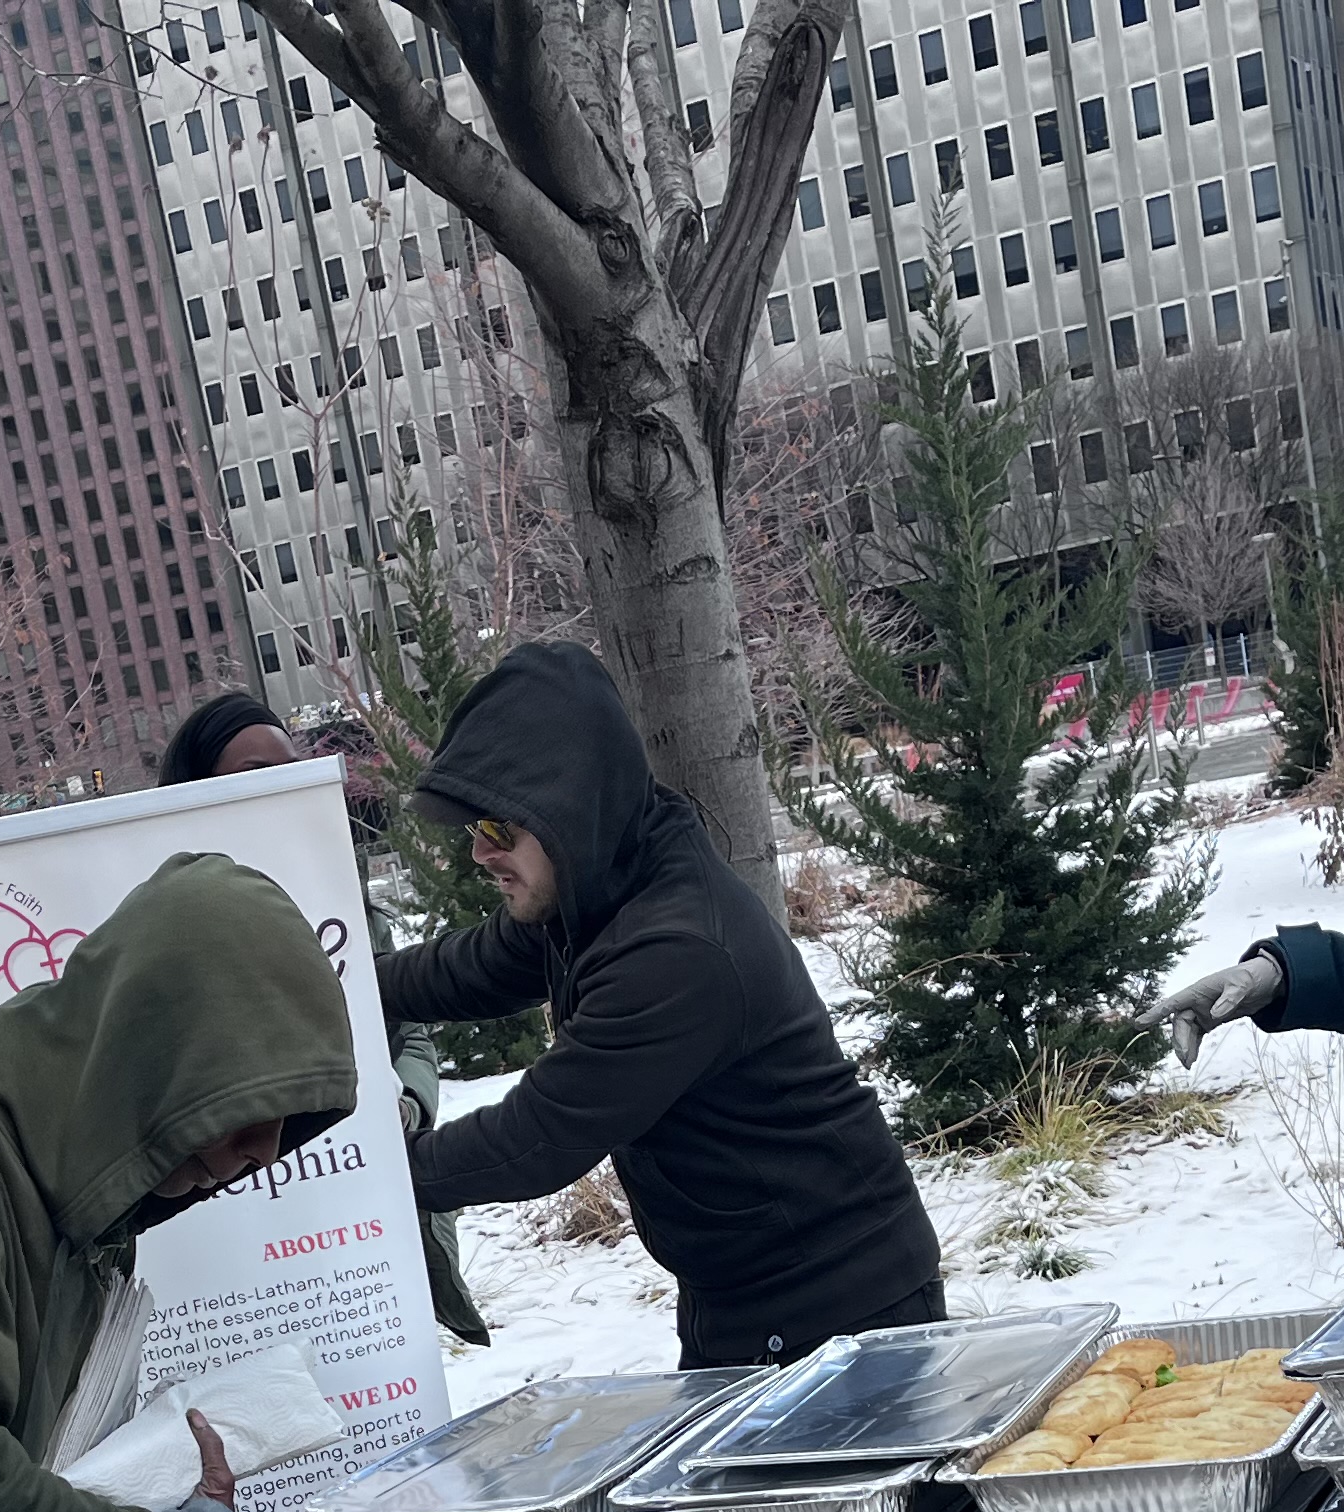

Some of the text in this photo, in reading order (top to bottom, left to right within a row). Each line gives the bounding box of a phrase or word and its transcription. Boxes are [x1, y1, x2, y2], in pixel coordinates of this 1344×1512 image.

[5, 883, 44, 916] Faith
[263, 1219, 383, 1262] ABOUT US
[192, 1276, 331, 1314] Fields-Latham,
[333, 1260, 391, 1284] known
[142, 1324, 181, 1344] ody
[186, 1319, 218, 1333] the
[223, 1301, 299, 1327] essence
[304, 1292, 323, 1310] of
[142, 1295, 399, 1362] itional love, as described in 1
[309, 1321, 382, 1348] ntinues
[384, 1316, 402, 1330] to
[321, 1335, 406, 1365] to service
[339, 1377, 418, 1411] WE DO
[340, 1408, 422, 1439] upport to
[353, 1434, 387, 1455] and
[391, 1425, 425, 1446] safe
